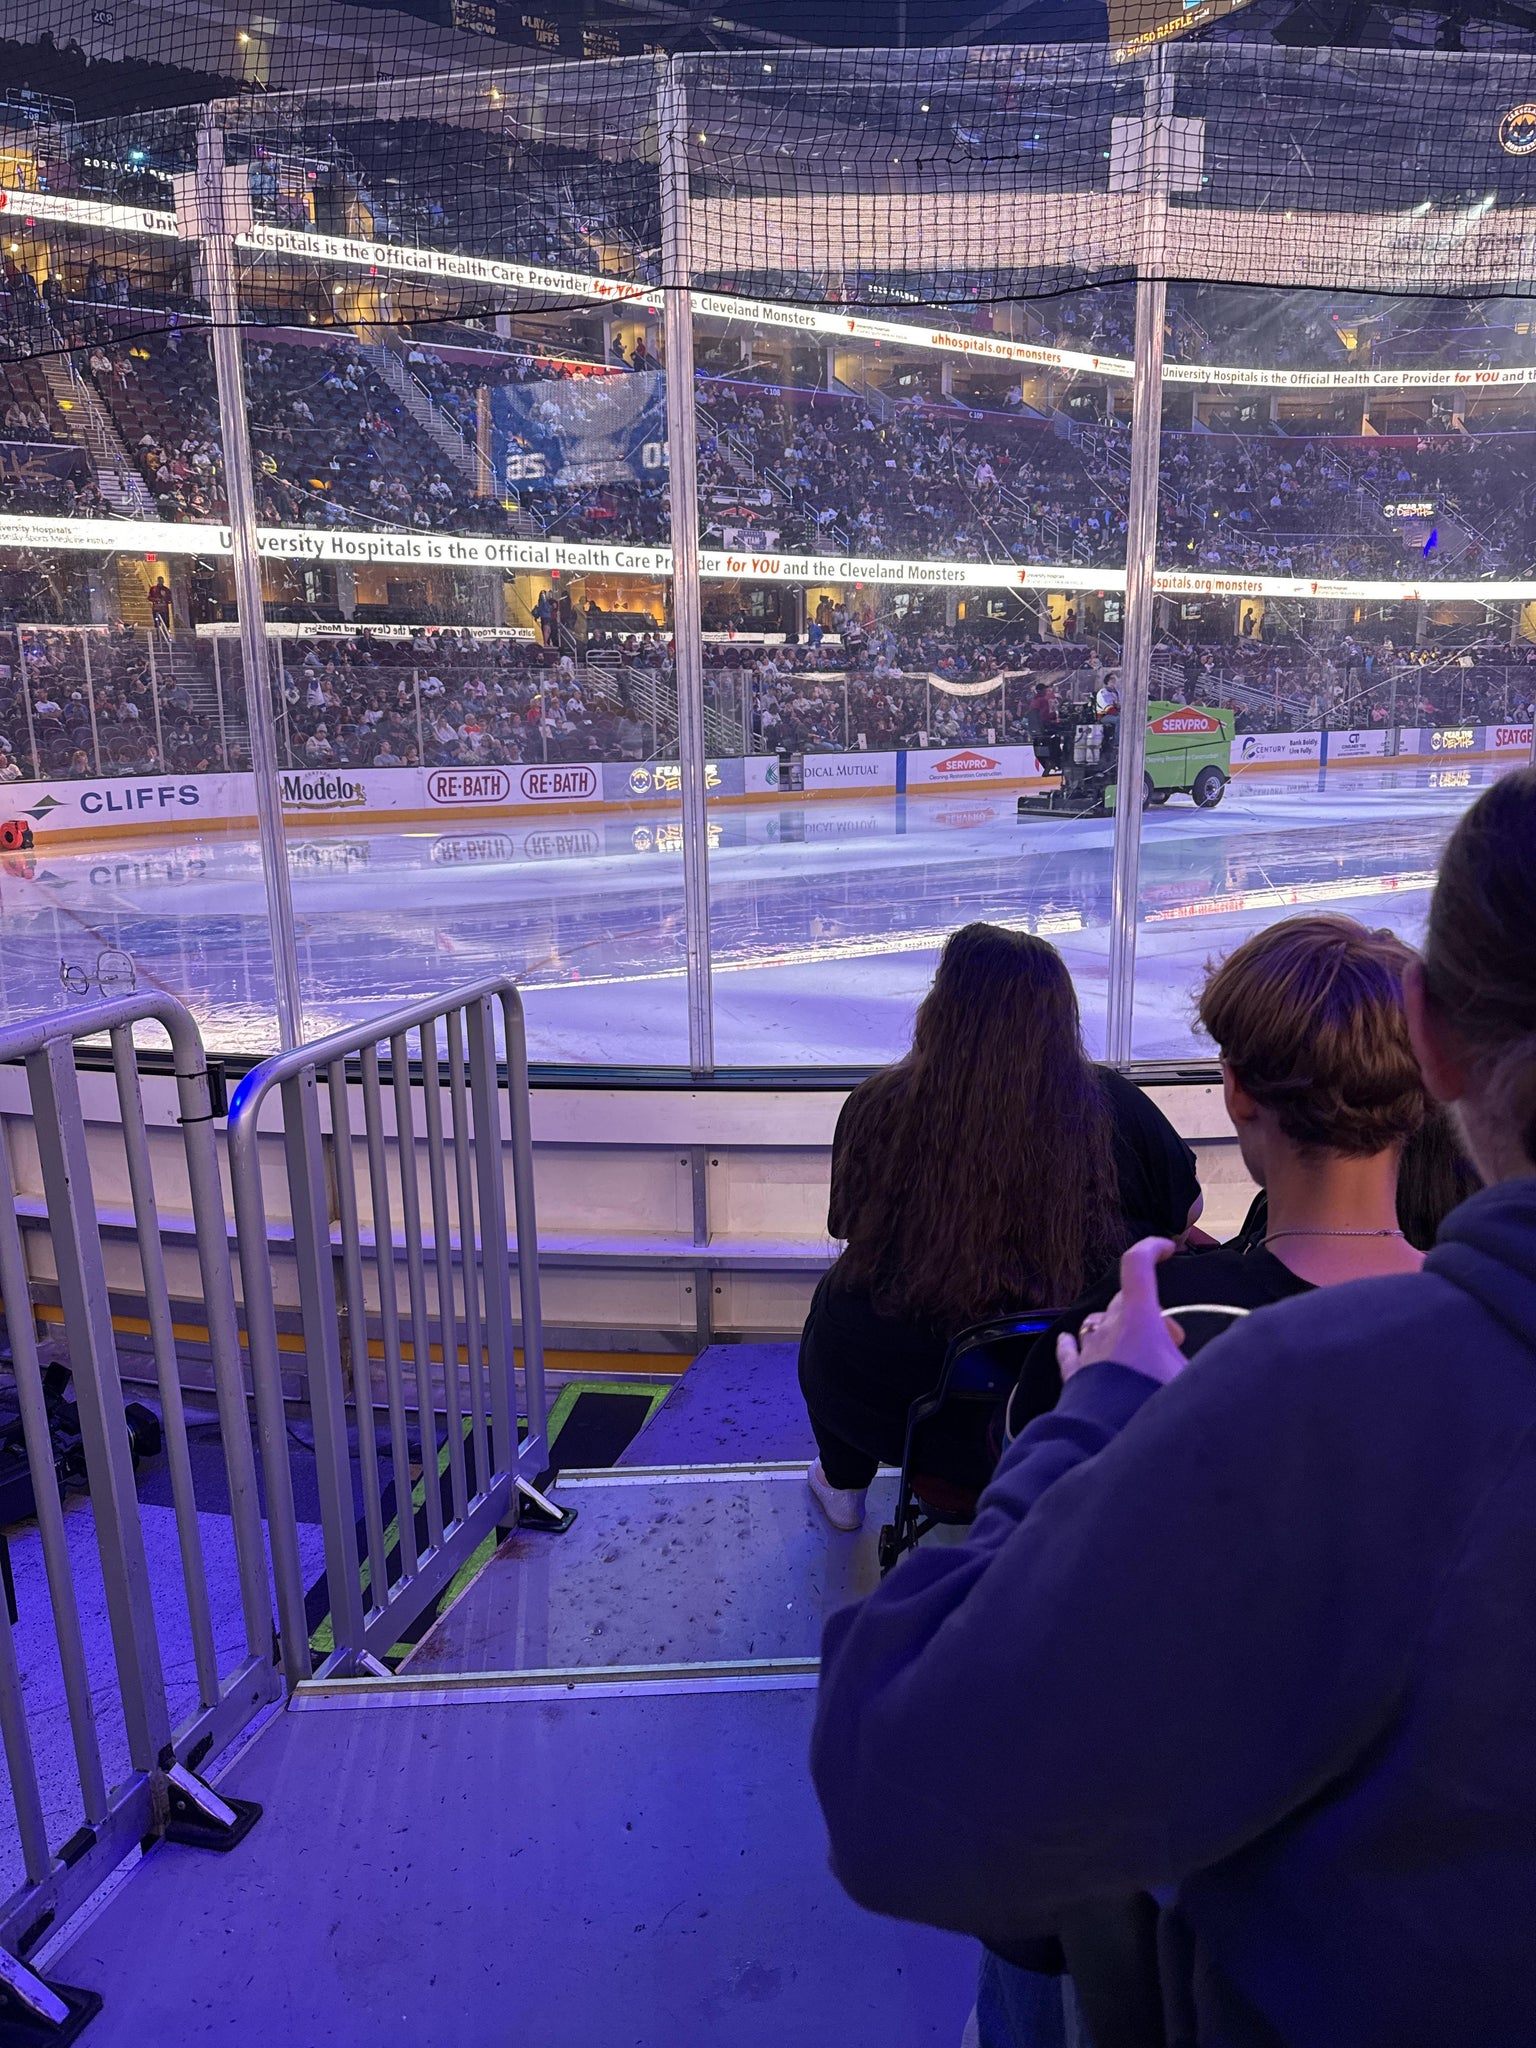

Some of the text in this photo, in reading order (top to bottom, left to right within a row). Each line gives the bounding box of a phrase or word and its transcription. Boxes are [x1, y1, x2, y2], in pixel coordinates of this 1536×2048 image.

[1156, 12, 1193, 39] RAFFLE
[23, 111, 40, 121] 208
[245, 234, 320, 254] Hospitals
[325, 239, 338, 255] is
[343, 243, 370, 260] the
[375, 248, 432, 270] Official
[437, 257, 487, 277] Health
[491, 265, 525, 283] Care
[529, 271, 588, 293] Provider
[593, 280, 613, 297] for
[701, 297, 759, 318] Cleveland
[763, 308, 816, 327] Monsters
[931, 333, 1062, 364] uhhospitals.org/monsters
[1162, 367, 1211, 384] University
[1213, 370, 1258, 384] Hospitals
[1261, 374, 1268, 383] is
[1271, 374, 1287, 384] the
[1290, 373, 1329, 385] Official
[1333, 374, 1370, 385] Health
[1373, 374, 1398, 384] Care
[1402, 372, 1451, 384] Provider
[1454, 373, 1471, 383] for
[1475, 372, 1500, 383] YOU
[1502, 371, 1524, 382] and
[0, 524, 72, 535] versity Hospitals
[219, 532, 965, 582] Uversity Hospitals is the Official Health Care Prder for YOU and the Cleveland Monsters
[1152, 574, 1263, 593] ospitals.org/monsters
[1162, 719, 1209, 731] SERVPRO
[1495, 728, 1532, 747] SEATGE
[1256, 746, 1286, 754] CENTURY
[655, 765, 681, 777] FEA
[804, 764, 879, 778] DICAL MUTUAL
[946, 759, 988, 770] SERVPRO
[283, 776, 354, 801] Modelo
[80, 784, 200, 814] CLIFFS
